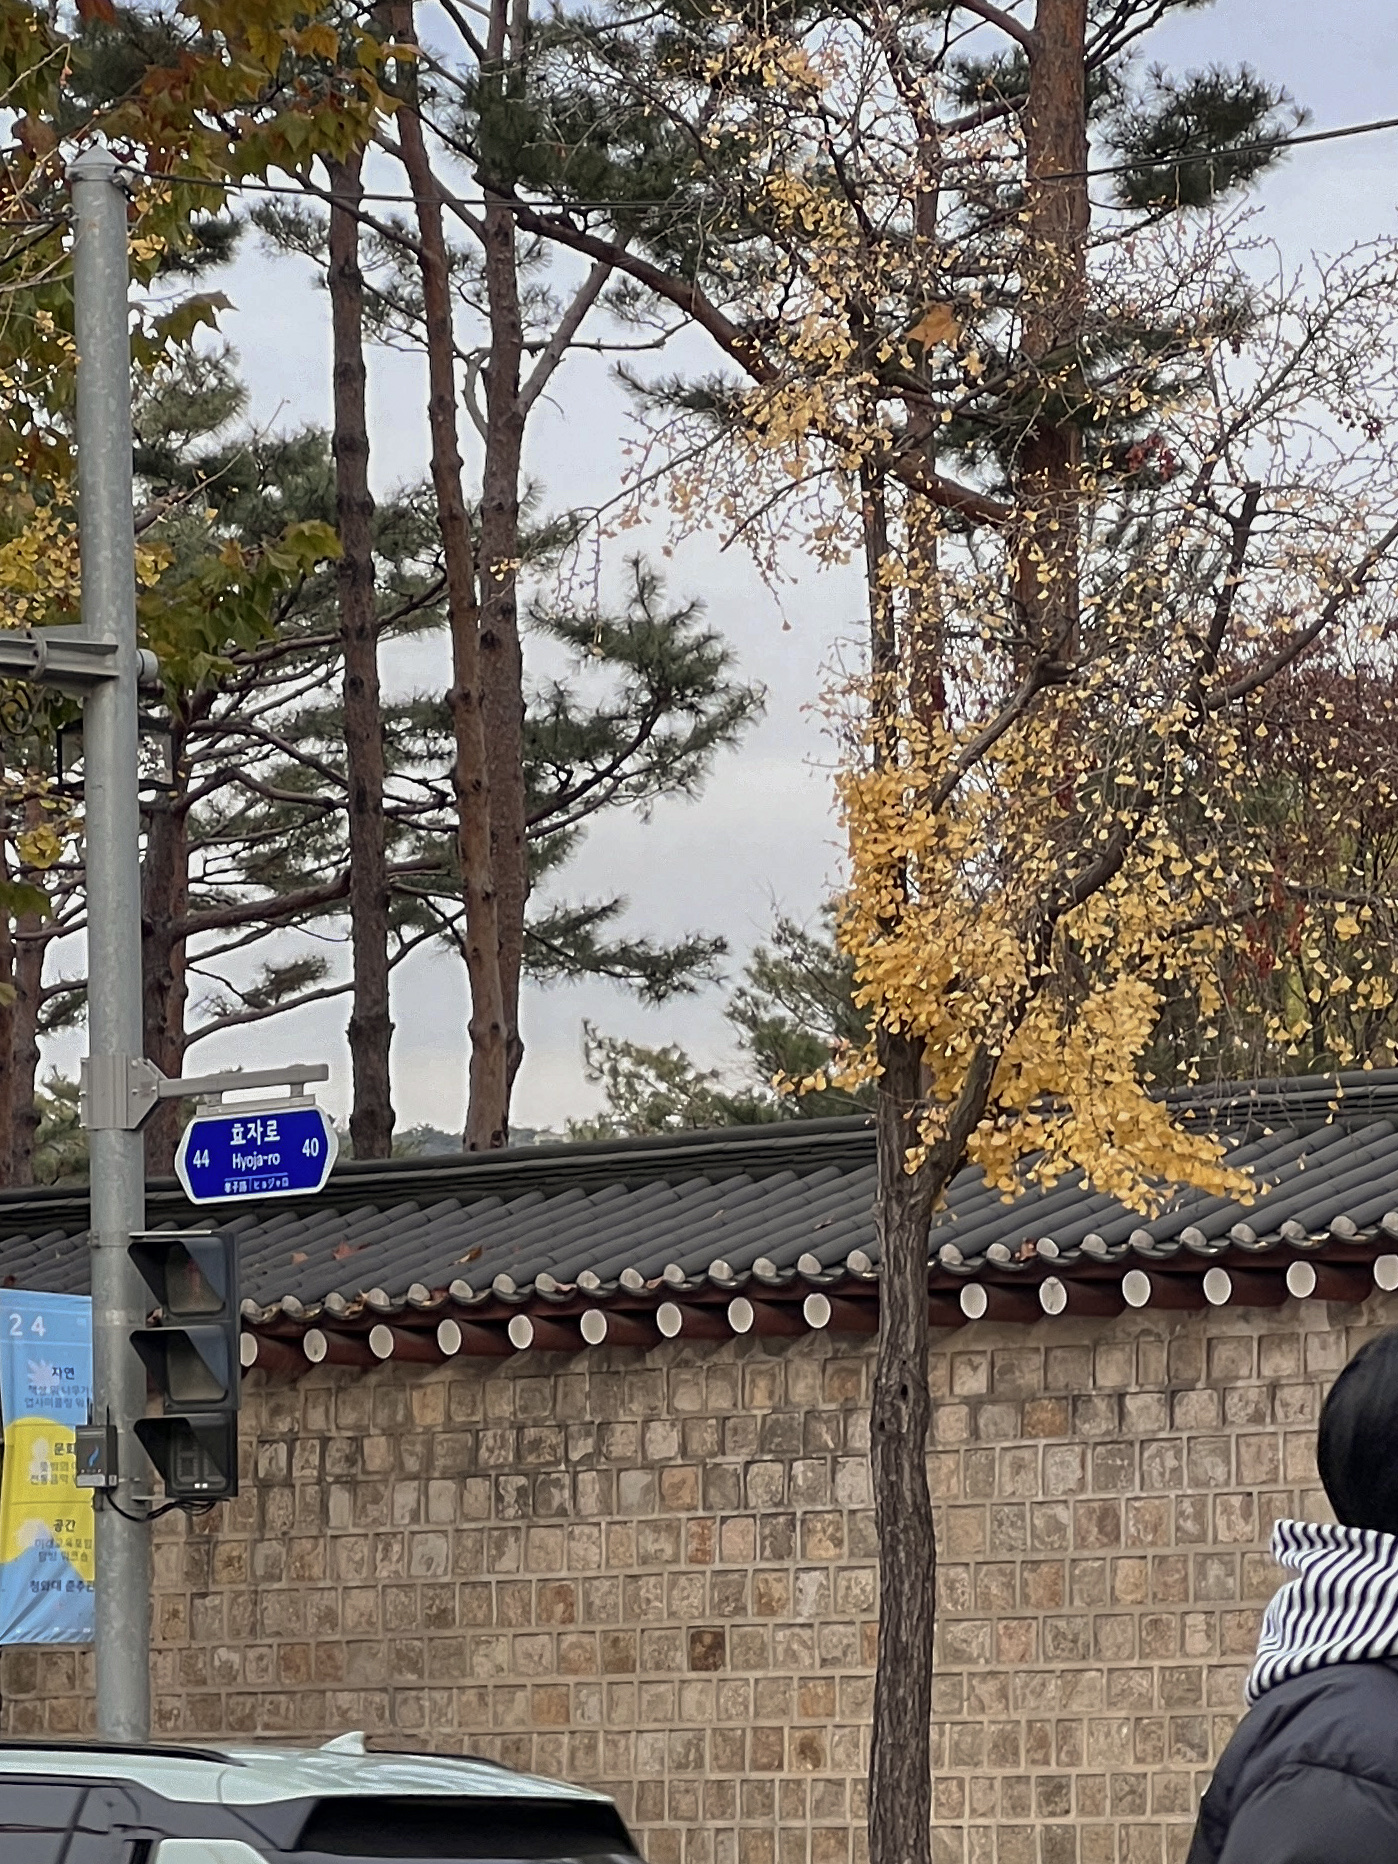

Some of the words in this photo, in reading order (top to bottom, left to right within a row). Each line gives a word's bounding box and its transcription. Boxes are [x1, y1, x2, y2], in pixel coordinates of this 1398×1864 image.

[229, 1118, 281, 1146] 효자로
[301, 1137, 320, 1158] 40
[192, 1148, 210, 1169] 44
[231, 1150, 281, 1172] Hyoja-ro
[51, 1366, 76, 1381] 자연
[53, 1518, 76, 1533] 공간
[29, 1579, 62, 1593] 청와대
